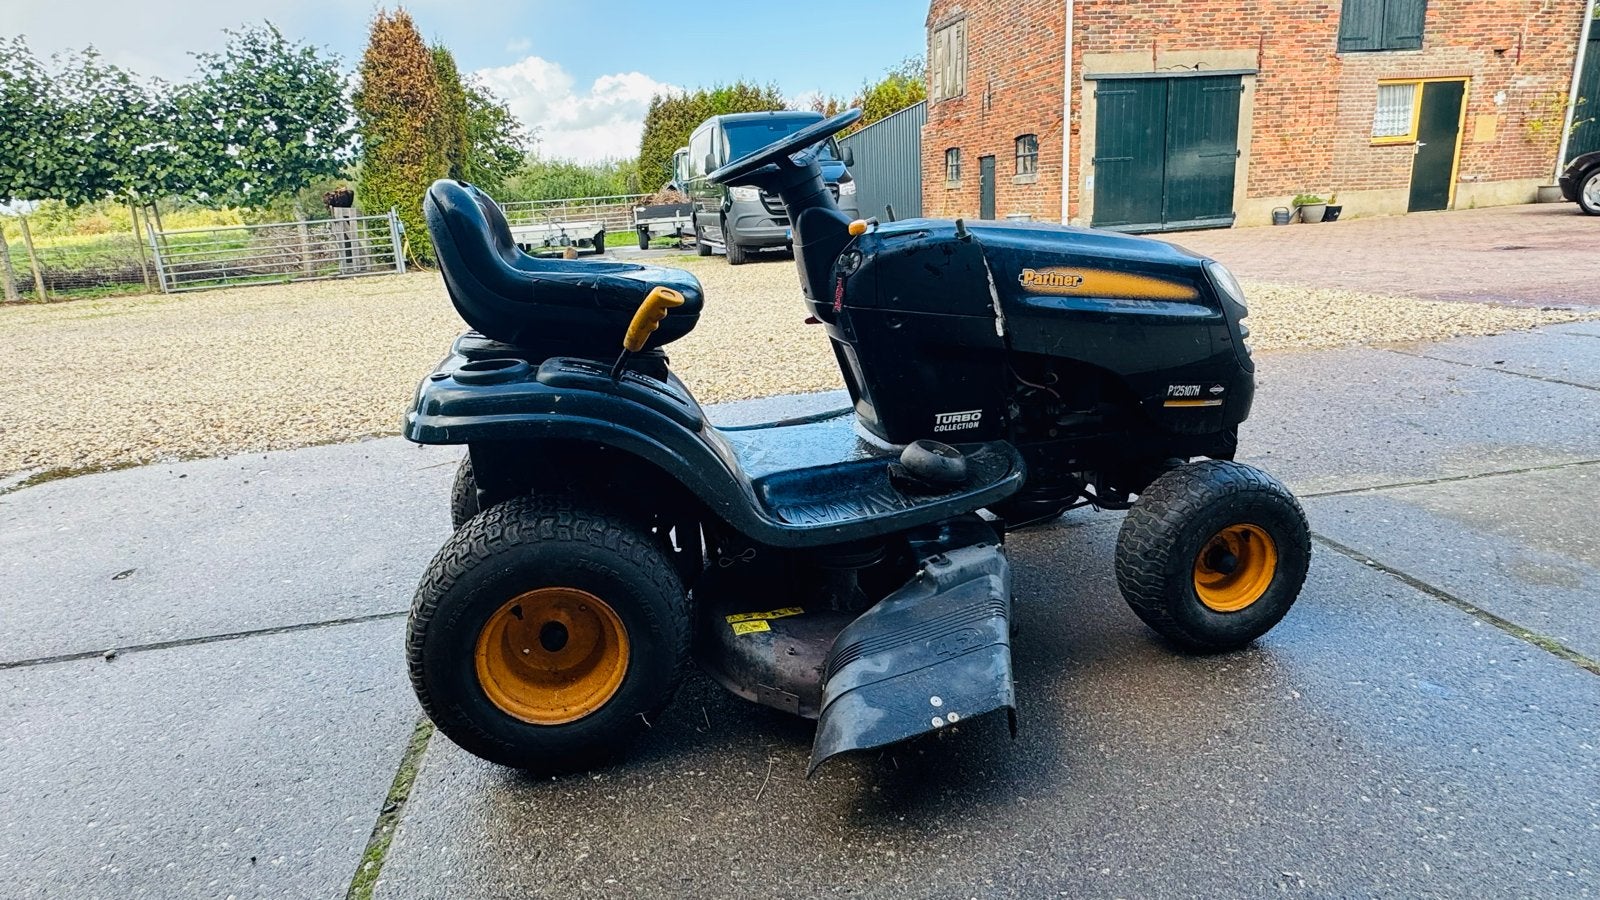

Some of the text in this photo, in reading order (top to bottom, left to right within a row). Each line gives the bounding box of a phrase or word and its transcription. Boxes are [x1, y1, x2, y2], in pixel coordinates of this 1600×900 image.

[1021, 269, 1081, 287] Partner
[1168, 384, 1201, 396] P125107H
[935, 409, 982, 424] TURBO
[934, 421, 979, 432] COLLECTION
